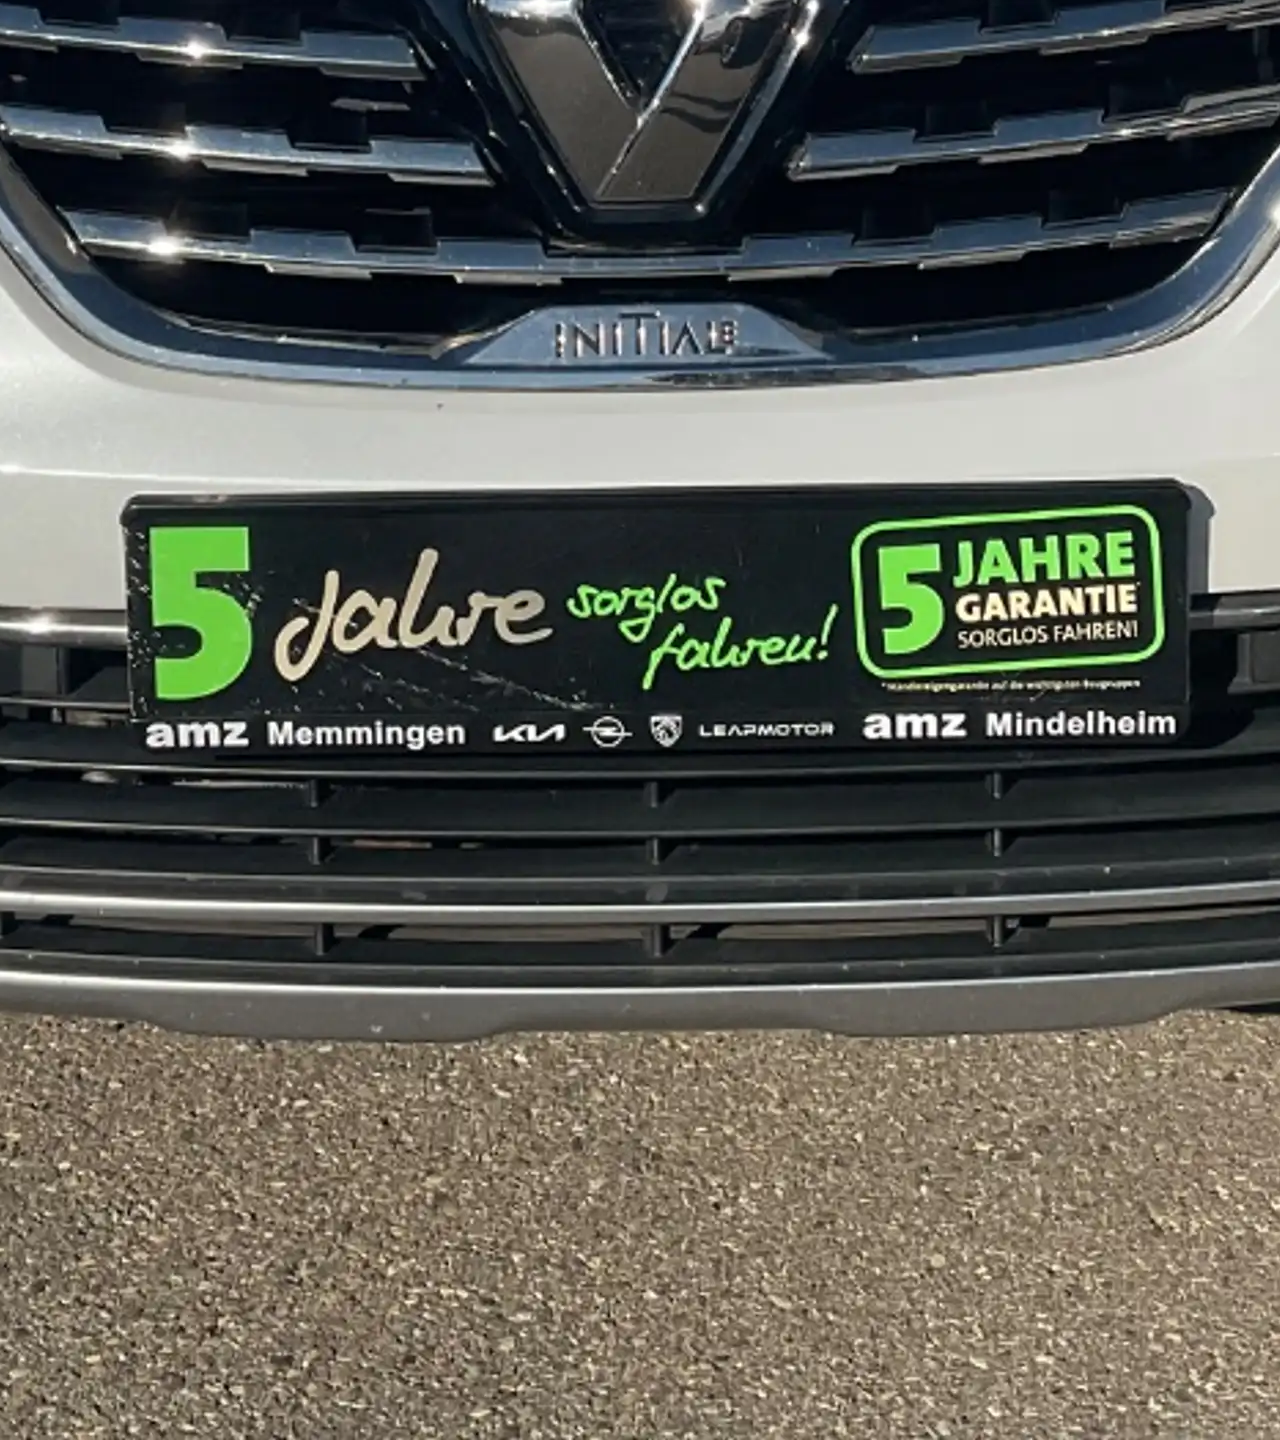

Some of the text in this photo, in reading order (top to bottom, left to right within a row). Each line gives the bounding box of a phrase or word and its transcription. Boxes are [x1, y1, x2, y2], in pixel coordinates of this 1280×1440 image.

[952, 530, 1137, 589] JAHRE
[149, 526, 554, 700] 5 Jahre
[567, 573, 726, 643] sorglos
[878, 543, 946, 655] 5
[642, 603, 839, 691] fahren!
[957, 619, 1139, 650] SORGLOS FAHREN!
[146, 720, 466, 750] amz Memmingen
[699, 721, 835, 738] LEAPMOTOR
[863, 709, 1177, 739] amz Mindelheim
